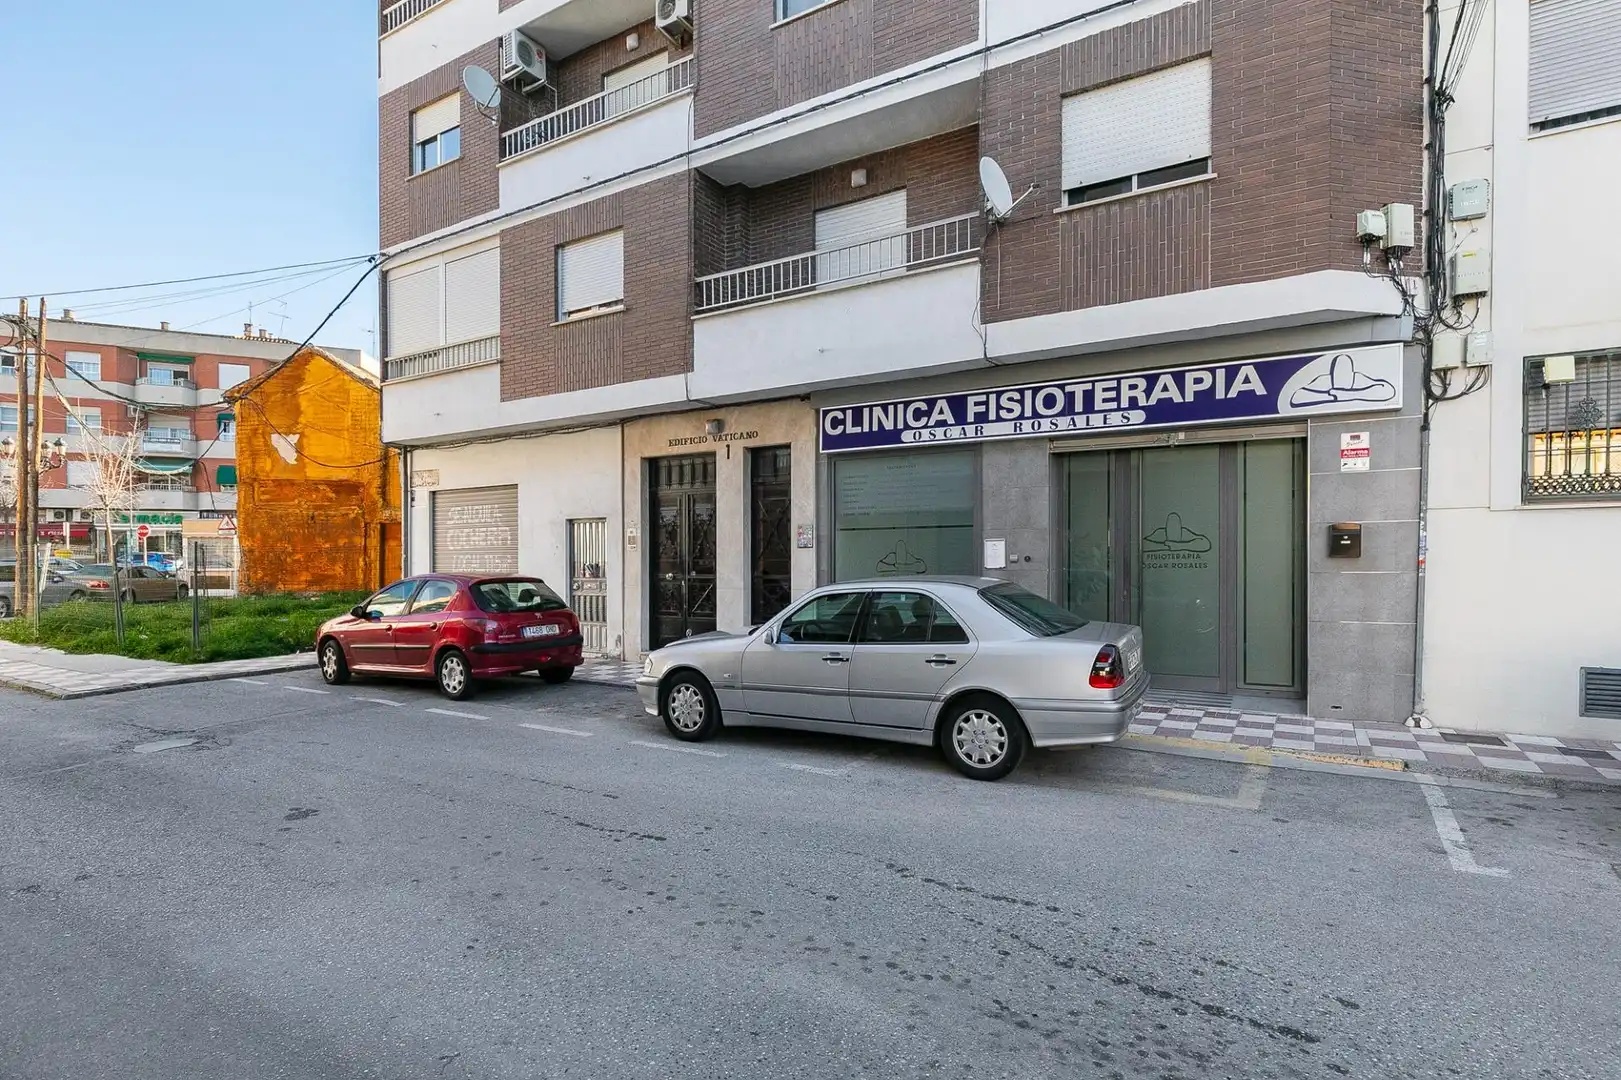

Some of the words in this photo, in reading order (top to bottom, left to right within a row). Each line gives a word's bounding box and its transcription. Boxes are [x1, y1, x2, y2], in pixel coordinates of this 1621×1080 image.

[824, 398, 955, 436] CLINICA
[967, 365, 1267, 423] FISIOTERAPIA
[912, 425, 985, 441] OSCAR
[1013, 411, 1131, 433] ROSALES
[668, 436, 708, 447] EDIFICIO
[712, 430, 759, 442] VATICANO
[725, 444, 730, 460] 1
